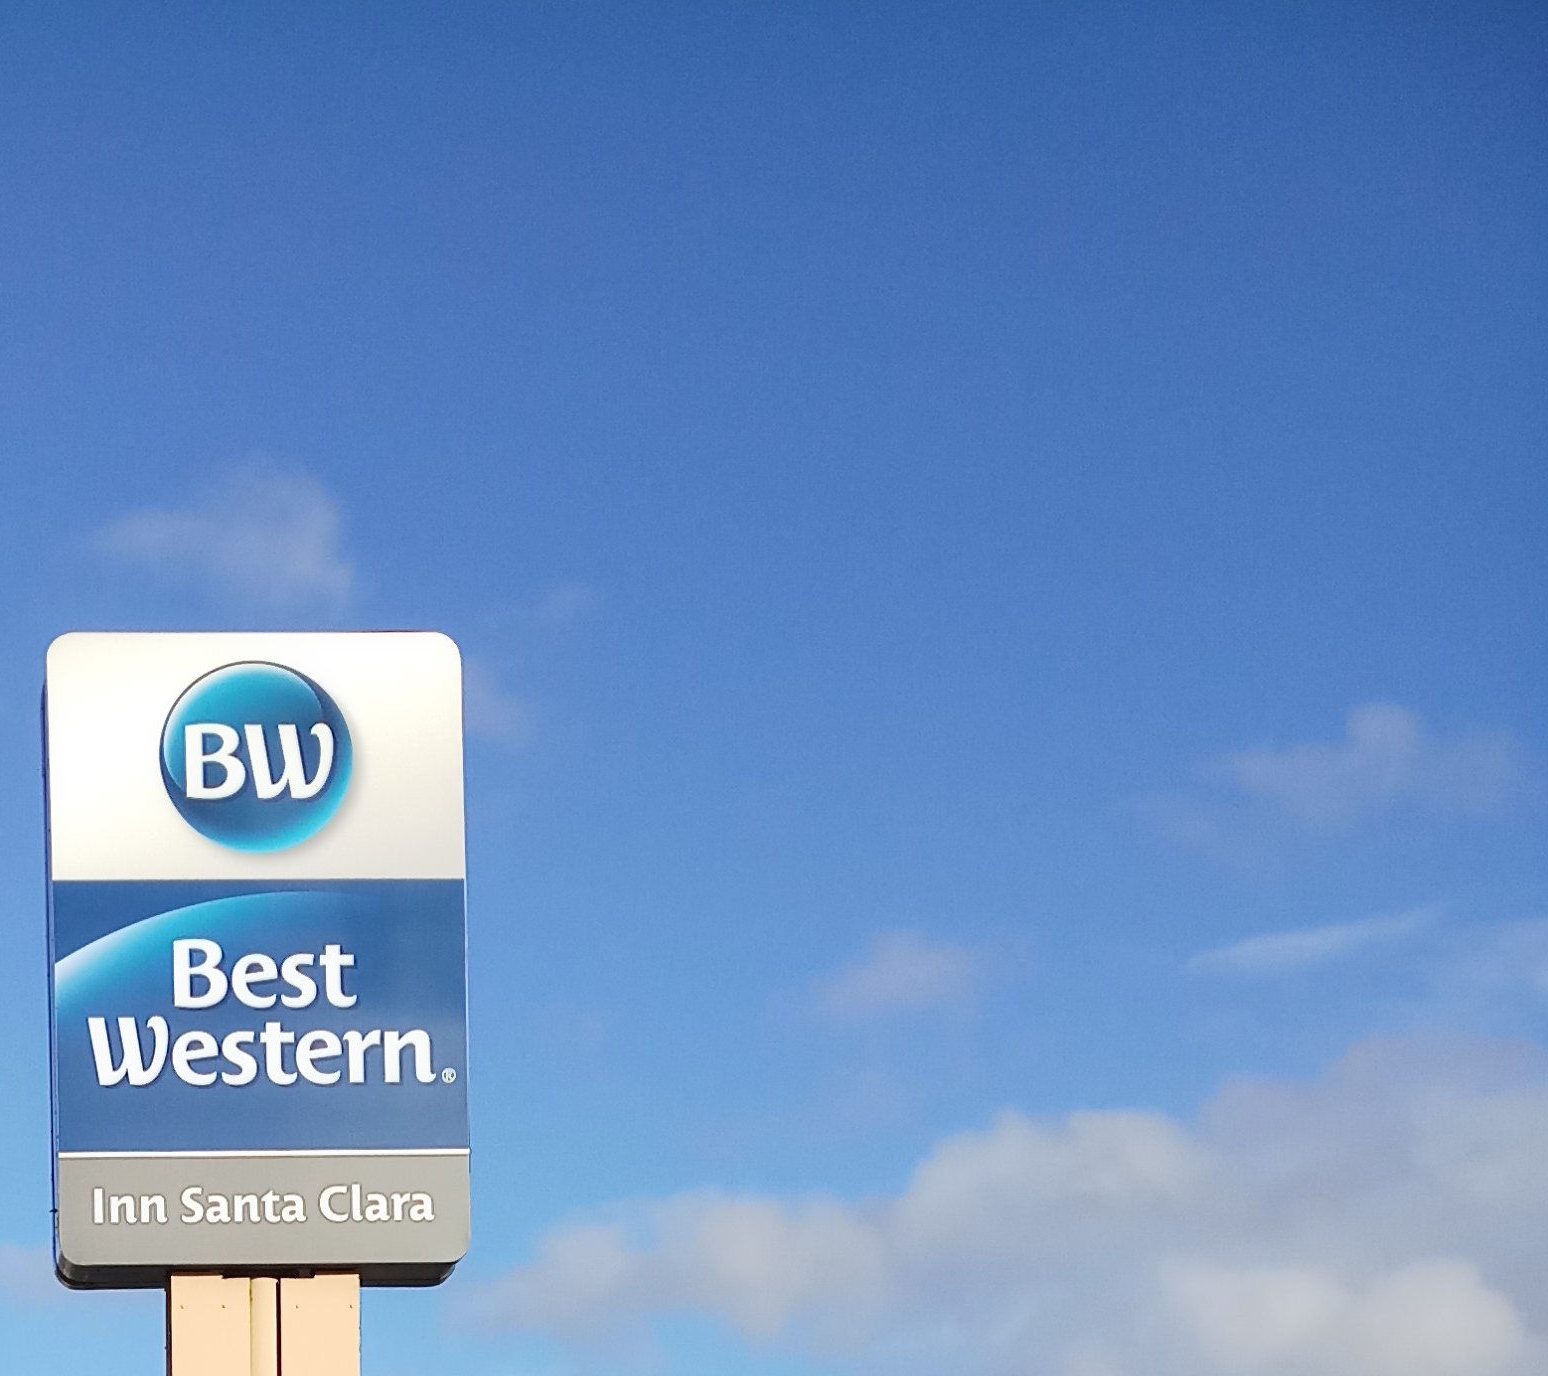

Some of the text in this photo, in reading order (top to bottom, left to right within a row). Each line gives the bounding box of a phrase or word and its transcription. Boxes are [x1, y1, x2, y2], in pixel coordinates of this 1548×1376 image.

[184, 722, 334, 800] BW
[172, 938, 358, 1009] Best
[92, 1183, 436, 1224] Inn Santa Clara
